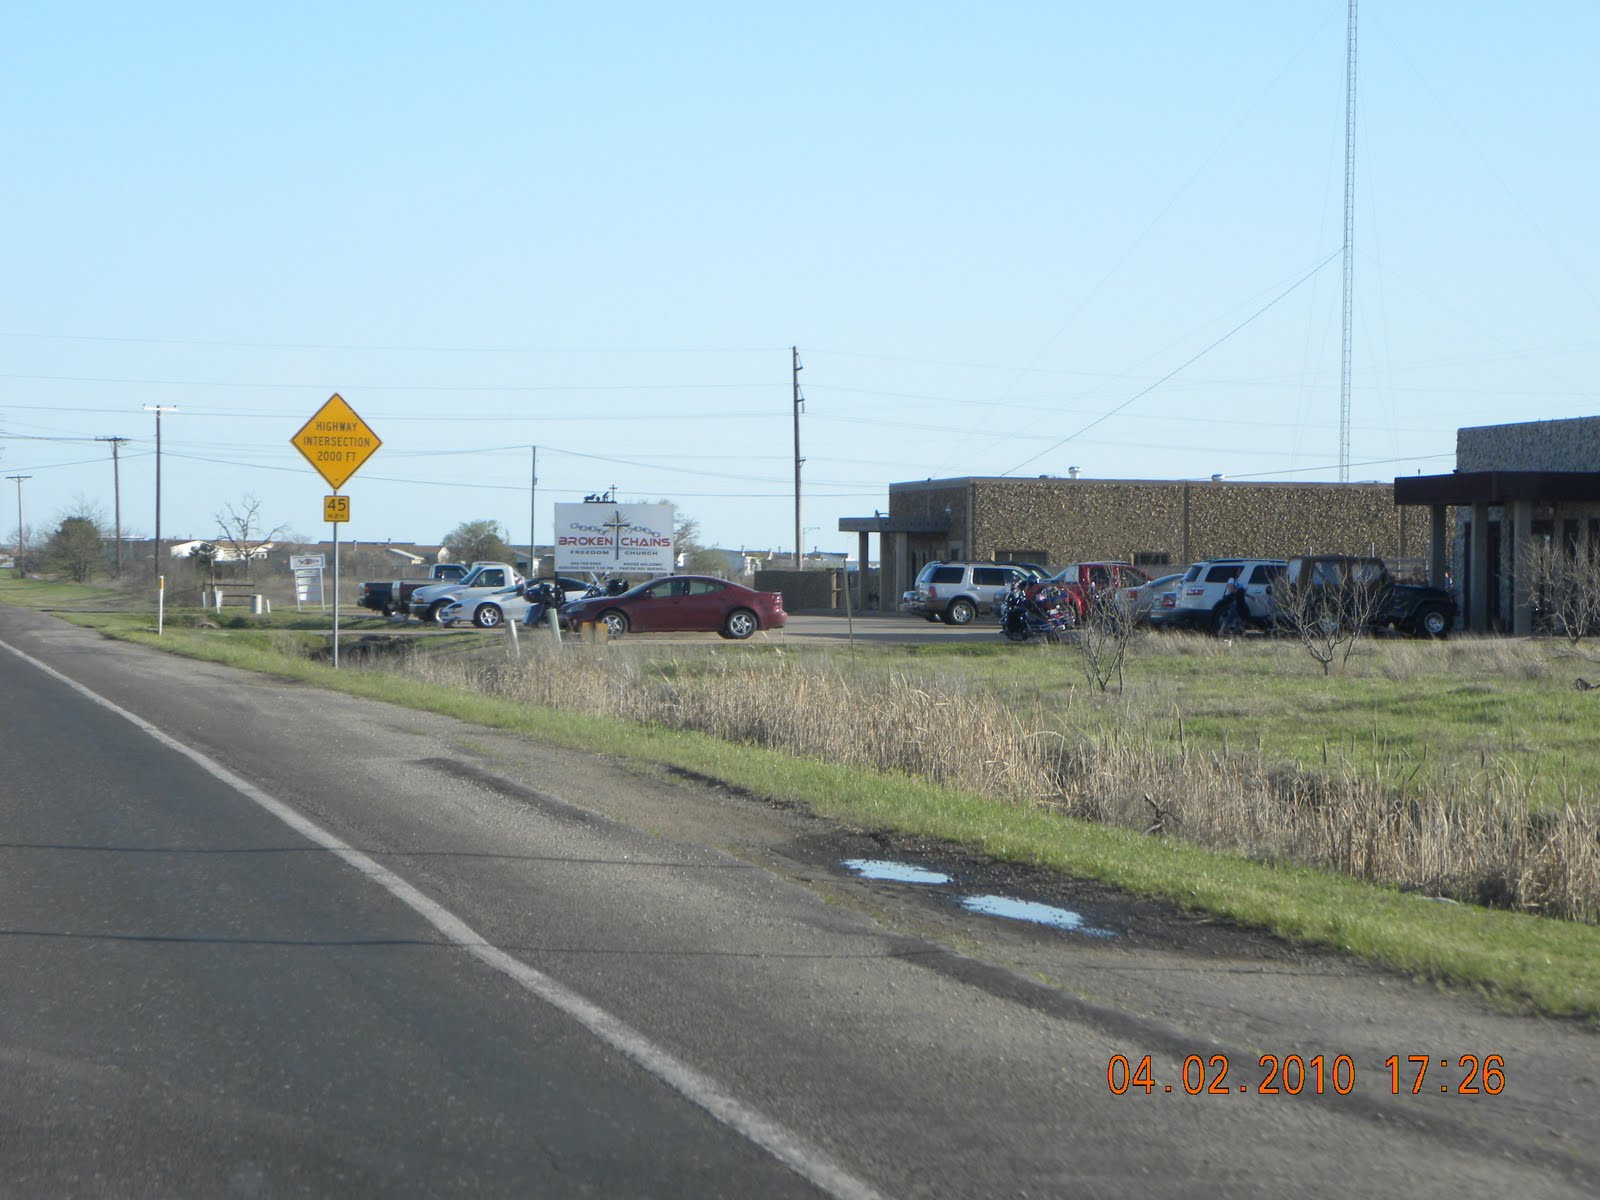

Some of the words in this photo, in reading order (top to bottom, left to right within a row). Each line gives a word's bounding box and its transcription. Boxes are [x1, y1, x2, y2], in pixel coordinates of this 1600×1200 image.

[316, 421, 358, 432] HIGHWAY
[303, 436, 370, 447] INTERSECTION
[317, 451, 342, 461] 2000
[345, 452, 357, 462] FT
[327, 498, 346, 512] 45
[558, 537, 613, 546] BROKEN
[620, 537, 671, 547] CHAINS
